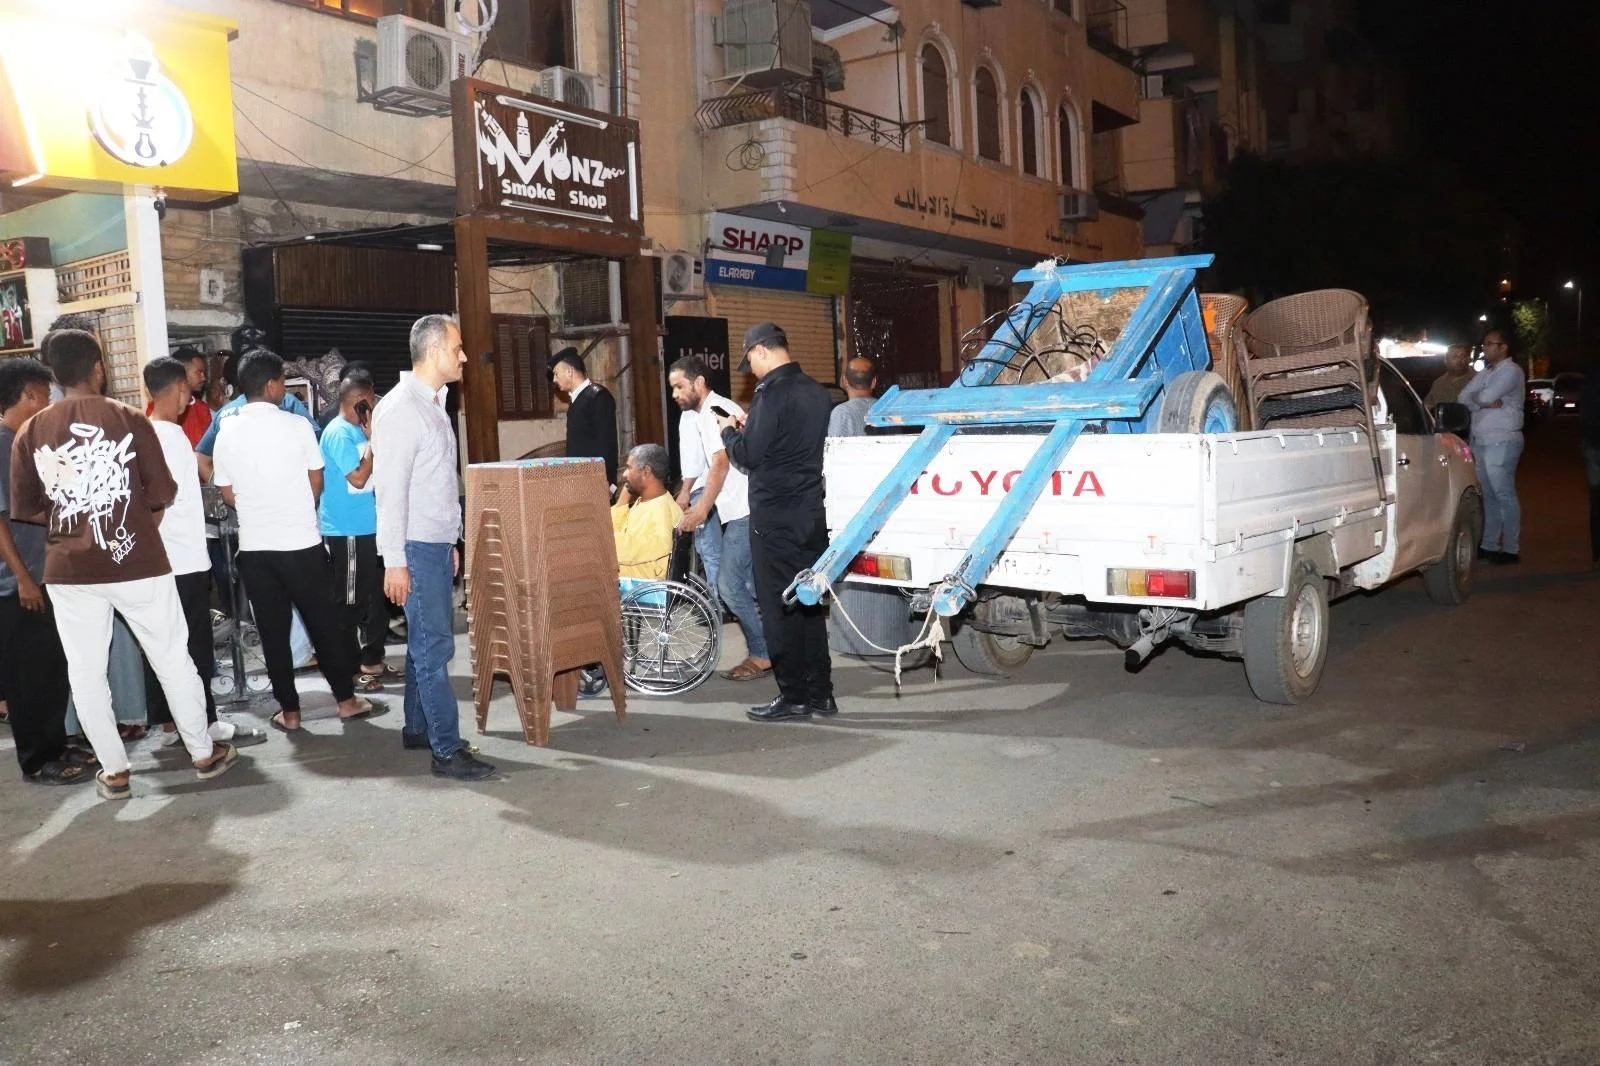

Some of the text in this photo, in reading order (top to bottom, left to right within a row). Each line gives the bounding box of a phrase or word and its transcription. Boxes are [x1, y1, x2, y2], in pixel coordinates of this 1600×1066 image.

[501, 178, 607, 209] Smoke Shop
[719, 266, 756, 280] ELARABY
